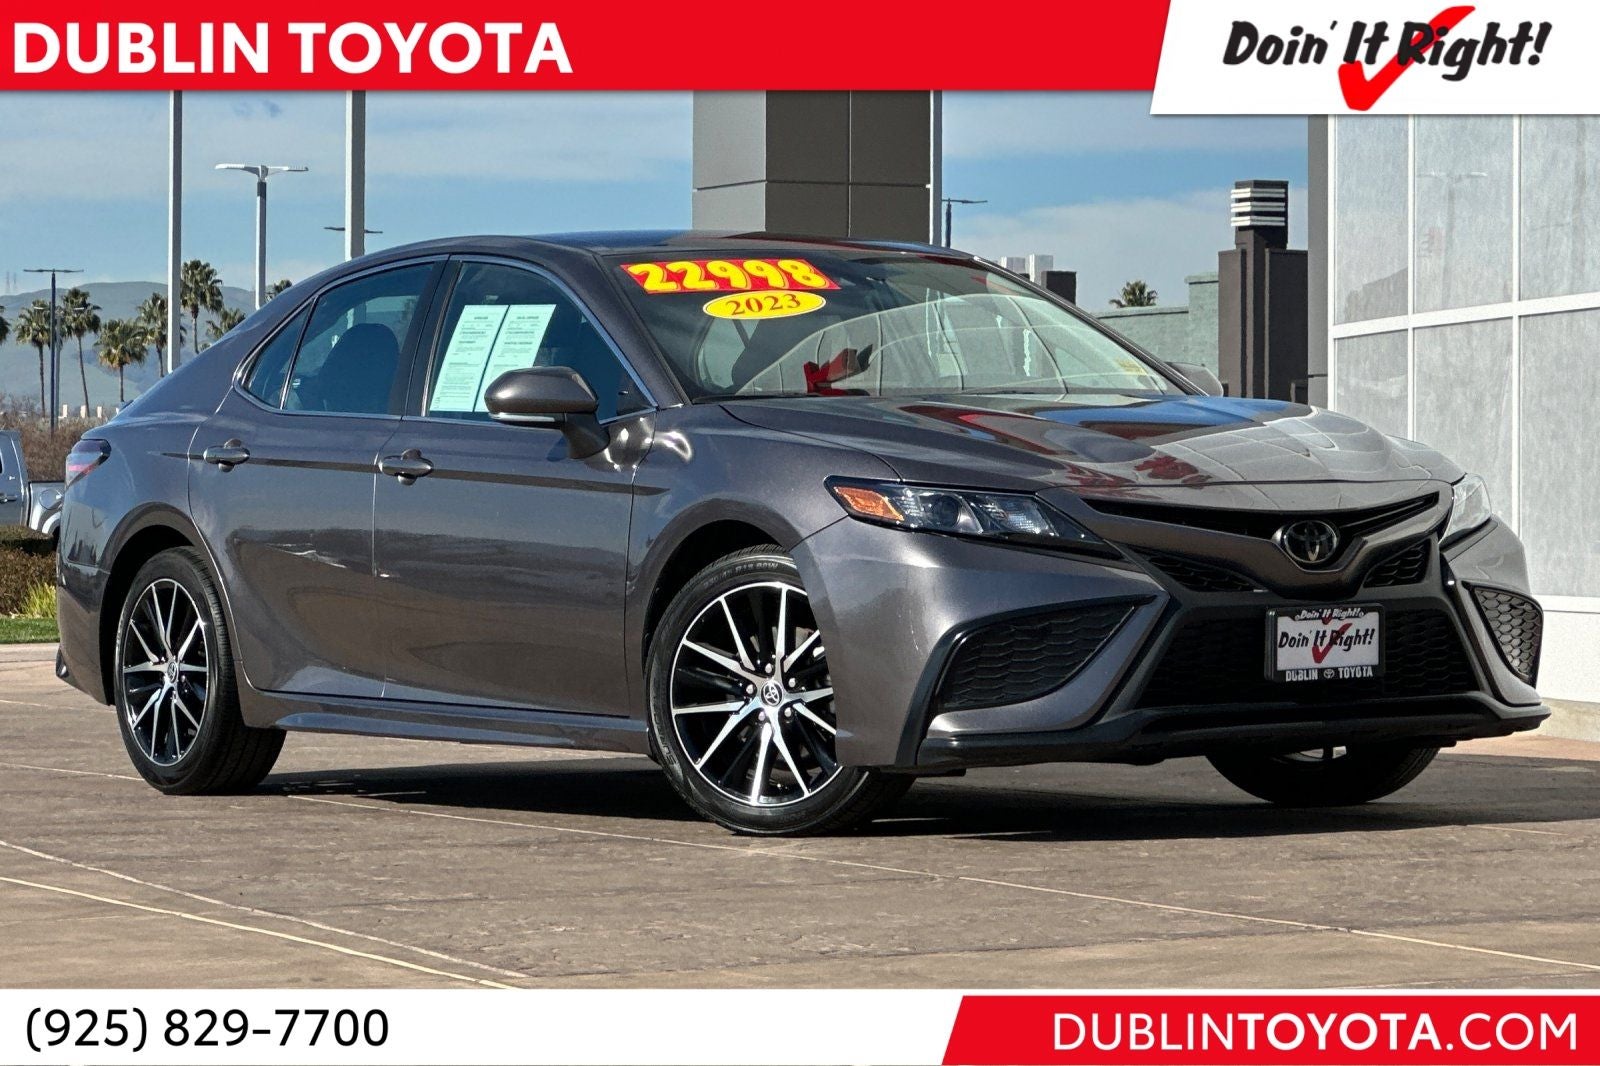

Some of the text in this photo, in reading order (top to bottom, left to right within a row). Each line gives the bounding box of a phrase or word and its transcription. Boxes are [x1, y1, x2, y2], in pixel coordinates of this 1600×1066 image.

[627, 259, 829, 291] 22998
[725, 293, 801, 315] 2023
[1300, 607, 1361, 620] Doin' It Right!
[1278, 628, 1375, 652] Doin' It Right!
[1285, 665, 1373, 682] DUBLIN TOYOTA
